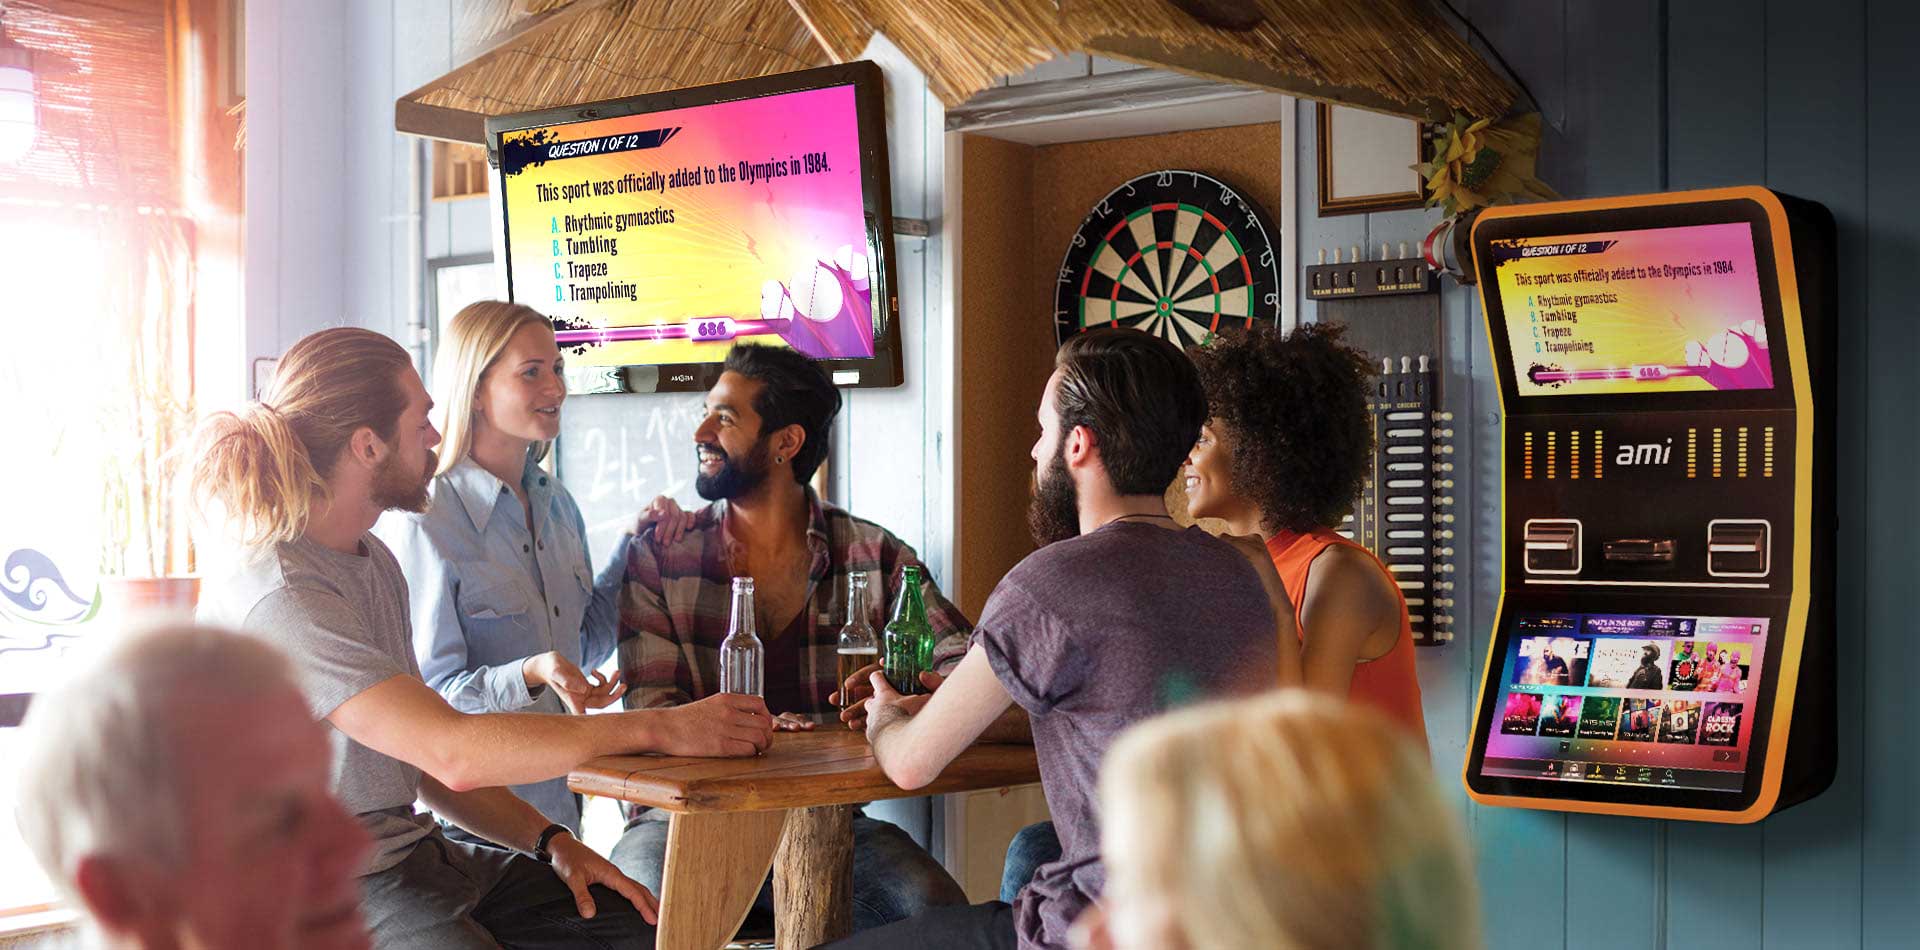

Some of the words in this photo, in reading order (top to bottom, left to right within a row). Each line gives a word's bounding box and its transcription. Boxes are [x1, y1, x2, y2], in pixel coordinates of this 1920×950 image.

[548, 139, 600, 158] QUESTION
[608, 136, 625, 150] OF
[625, 134, 639, 149] 12
[536, 183, 559, 203] This
[562, 180, 591, 203] sport
[593, 180, 614, 197] was
[617, 171, 666, 194] officially
[669, 166, 701, 188] added
[704, 166, 715, 185] to
[718, 163, 736, 183] the
[739, 157, 788, 185] Olympics
[790, 155, 801, 176] in
[802, 152, 832, 174] 1984.
[1156, 171, 1173, 187] 20
[551, 216, 561, 233] A.
[565, 211, 613, 235] Rhythmic
[616, 206, 675, 232] gymnastics
[552, 239, 563, 257] B.
[566, 235, 618, 256] Tumbling
[1521, 246, 1558, 257] QUESTION
[1565, 244, 1577, 254] OF
[1578, 243, 1587, 253] 12
[554, 262, 564, 279] C.
[567, 261, 608, 281] Trapeze
[1514, 273, 1532, 286] This
[1534, 272, 1555, 287] sport
[1556, 272, 1572, 283] was
[1573, 268, 1610, 283] officially
[1611, 266, 1636, 280] added
[1637, 267, 1646, 279] to
[1648, 265, 1662, 278] the
[1663, 262, 1702, 280] Olympics
[1703, 262, 1712, 275] in
[1713, 260, 1736, 275] 1984.
[555, 285, 566, 302] D.
[569, 280, 637, 304] Trampolining
[1312, 288, 1331, 296] TEAM
[1537, 293, 1572, 309] Rhythmic
[1574, 292, 1618, 307] gymnastics
[1540, 309, 1577, 324] Tumbling
[697, 321, 727, 337] 686
[1542, 325, 1572, 339] Trapeze
[1639, 367, 1661, 378] 686
[1616, 437, 1673, 465] ami
[1707, 715, 1736, 723] CLASSIC
[1705, 722, 1735, 733] ROCK
